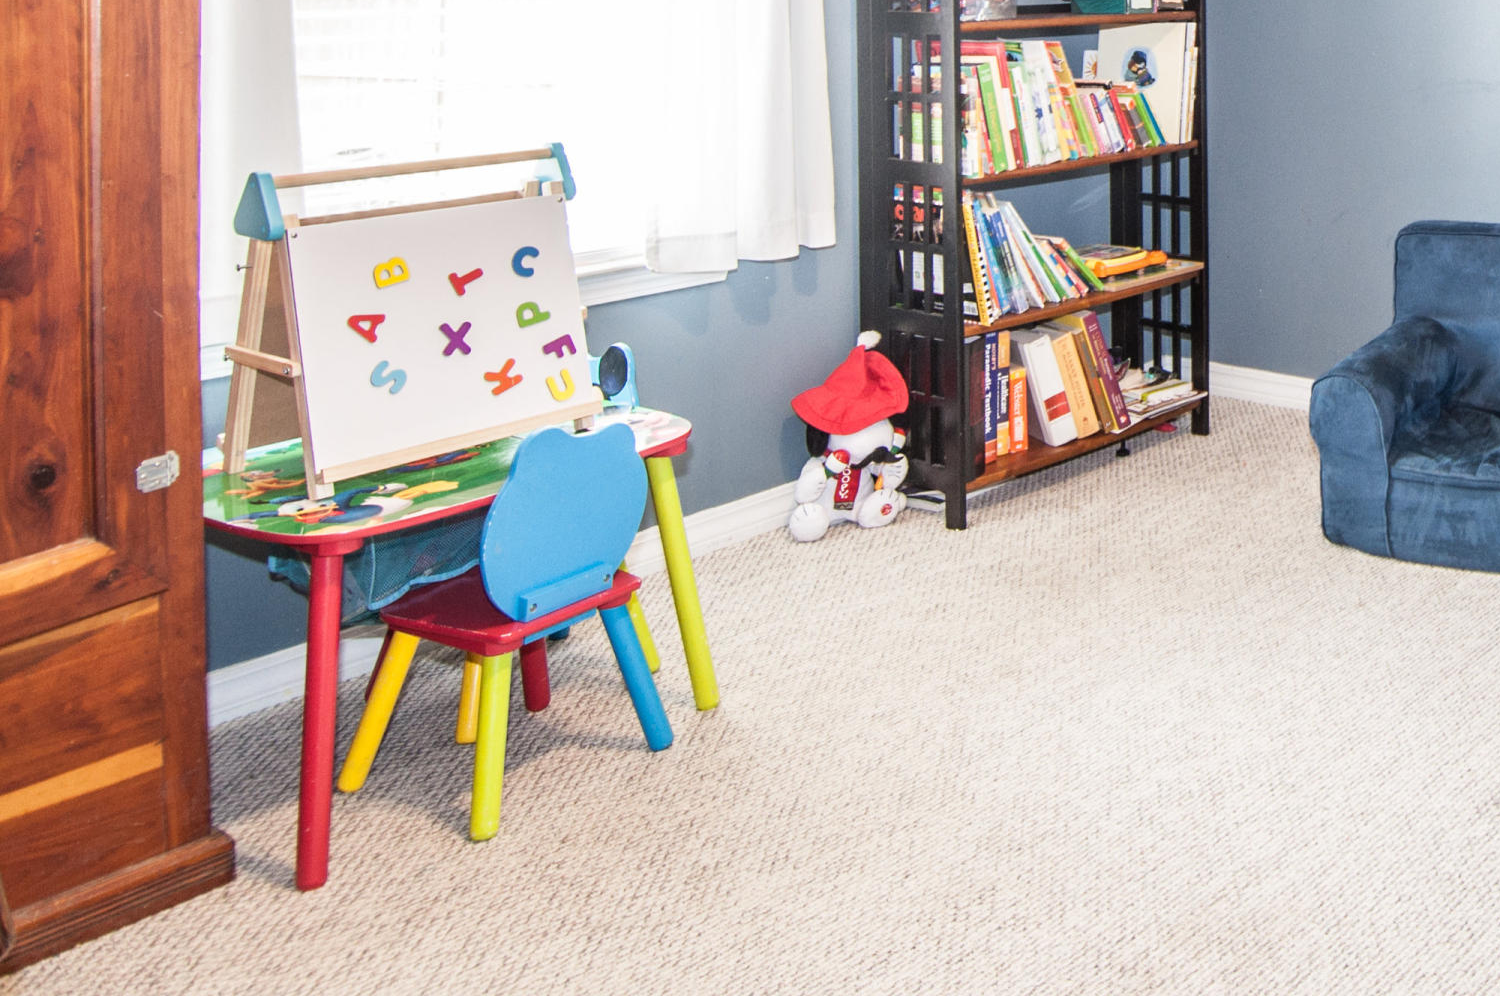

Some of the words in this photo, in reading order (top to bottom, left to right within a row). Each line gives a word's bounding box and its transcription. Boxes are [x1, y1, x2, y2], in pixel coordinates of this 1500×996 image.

[373, 256, 410, 289] B
[511, 246, 540, 277] C
[448, 267, 484, 297] T
[347, 313, 386, 344] A
[516, 301, 551, 328] P
[439, 321, 472, 356] X
[542, 334, 577, 358] F
[370, 359, 408, 395] S
[483, 358, 523, 396] K
[984, 344, 992, 391] Paramedic
[545, 368, 576, 402] U
[984, 392, 992, 435] Textbook
